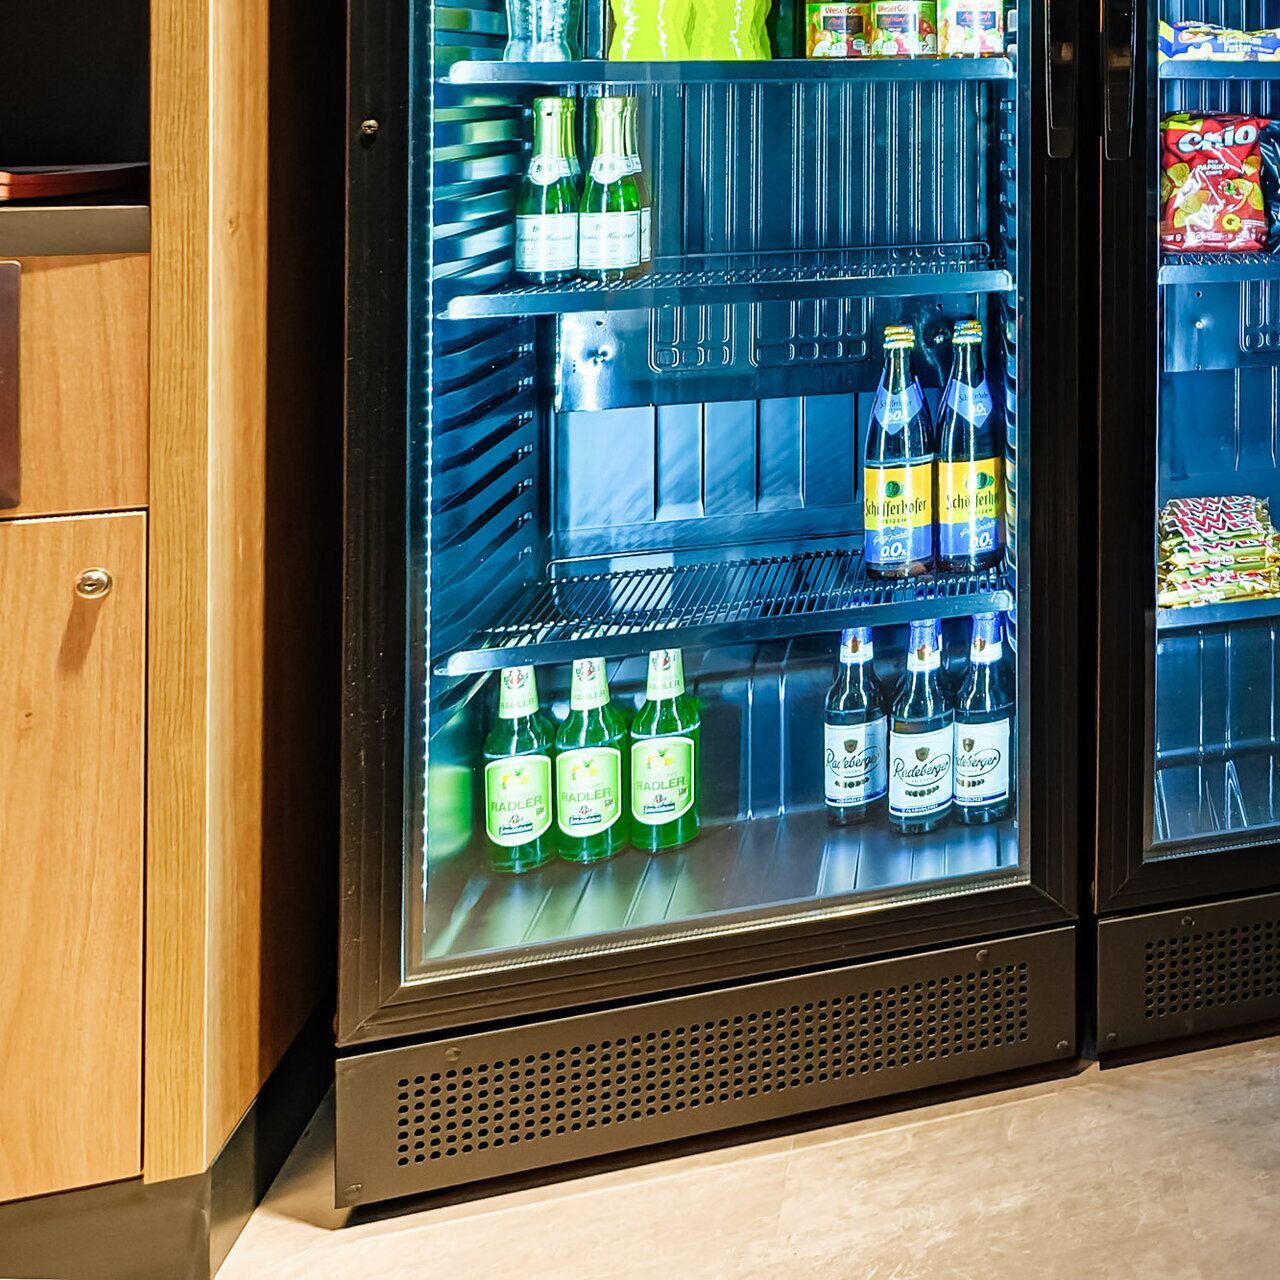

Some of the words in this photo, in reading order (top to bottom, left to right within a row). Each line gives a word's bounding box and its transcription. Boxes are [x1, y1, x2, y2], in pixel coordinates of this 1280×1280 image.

[893, 756, 950, 778] Radeberger
[636, 776, 685, 792] RADLER
[562, 787, 612, 803] RADLER
[491, 795, 543, 813] RADLER
